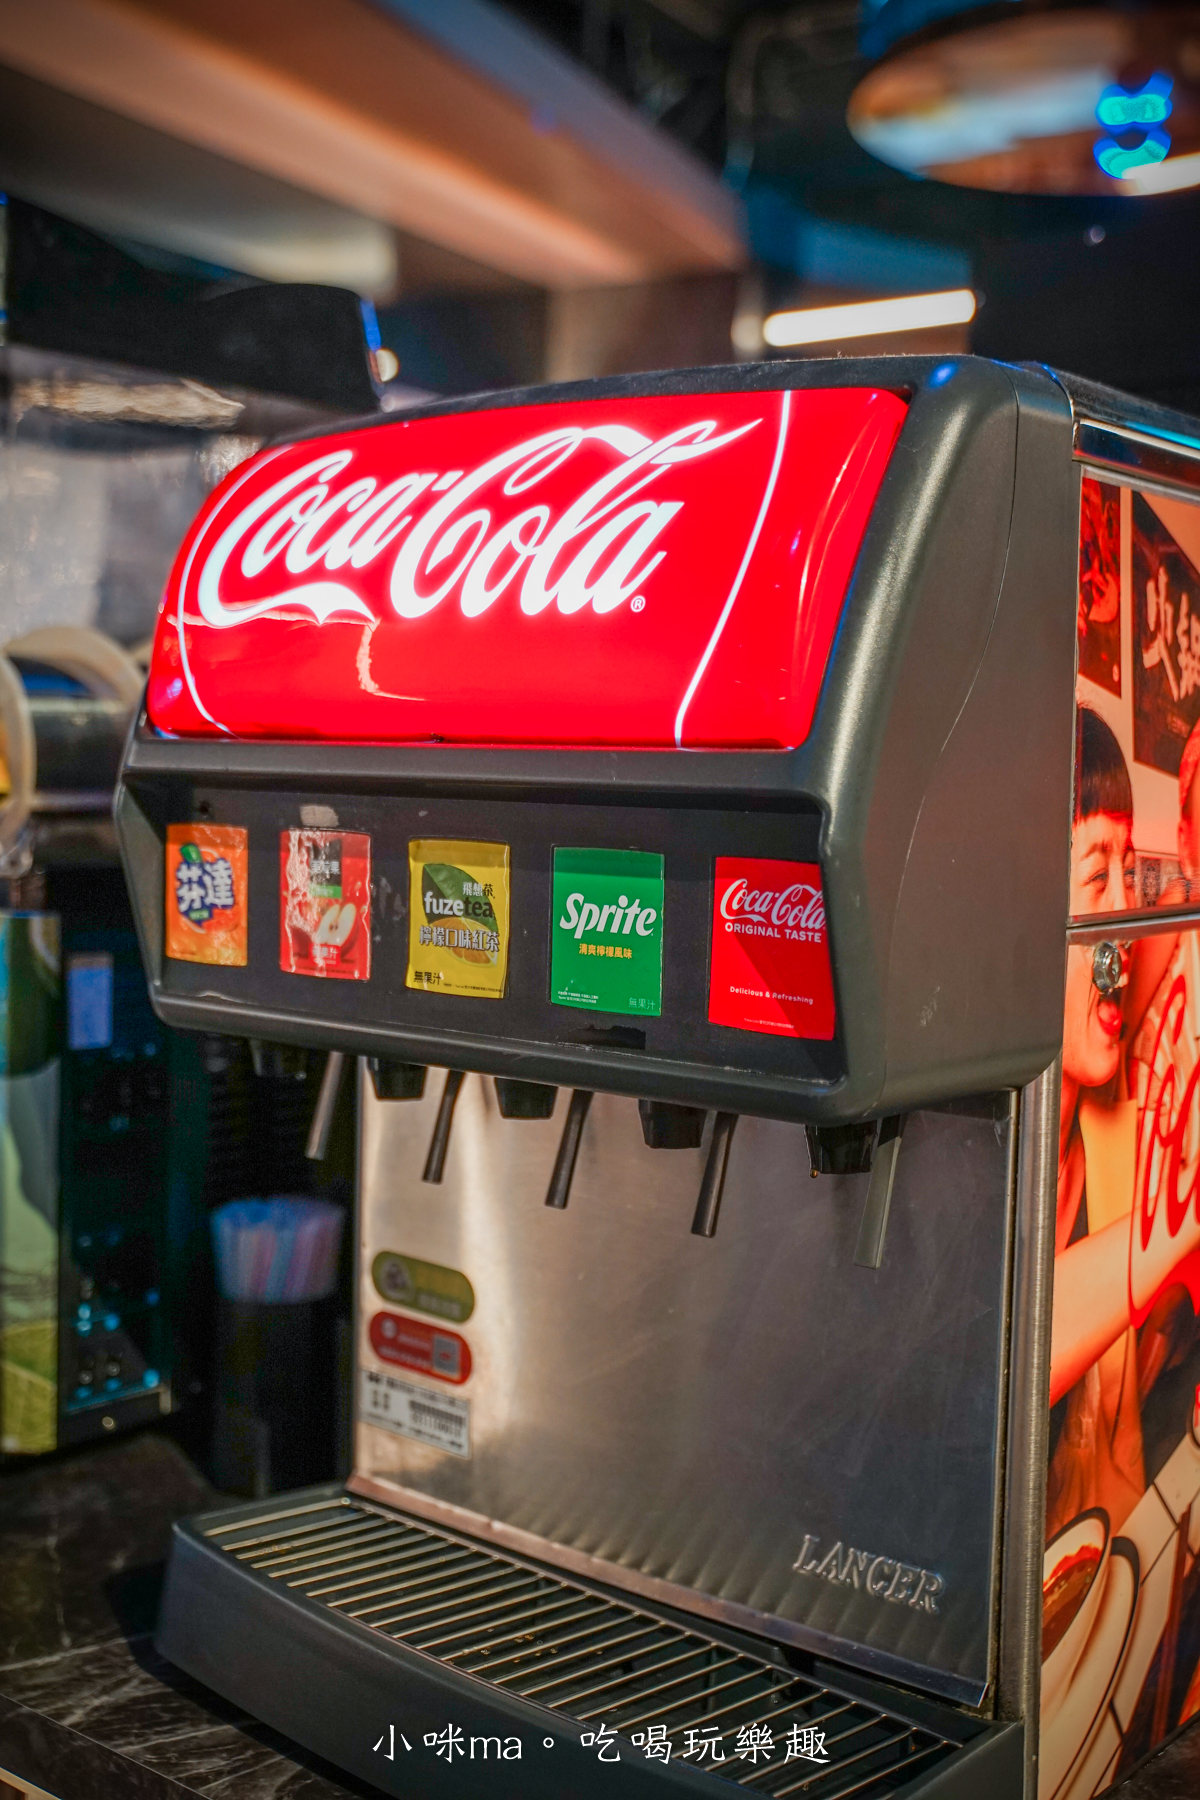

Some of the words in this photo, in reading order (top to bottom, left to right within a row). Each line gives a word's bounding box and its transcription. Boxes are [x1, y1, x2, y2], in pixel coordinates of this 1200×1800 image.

[197, 417, 764, 630] Coca-Cola
[176, 858, 234, 912] 芬達
[462, 882, 494, 897] 飛想茶
[559, 892, 657, 940] Sprite
[719, 878, 826, 930] Coca-Cola
[419, 925, 500, 952] 檸檬口味紅茶
[724, 922, 781, 938] ORIGINAL
[784, 928, 822, 943] TASTE
[578, 943, 633, 960] 清爽檸檬風味
[413, 970, 442, 986] 無果汁
[628, 997, 656, 1011] 無果汁
[729, 986, 763, 998] Delicious
[764, 990, 771, 998] &
[772, 992, 814, 1006] Refreshing
[792, 1534, 945, 1615] LANCER
